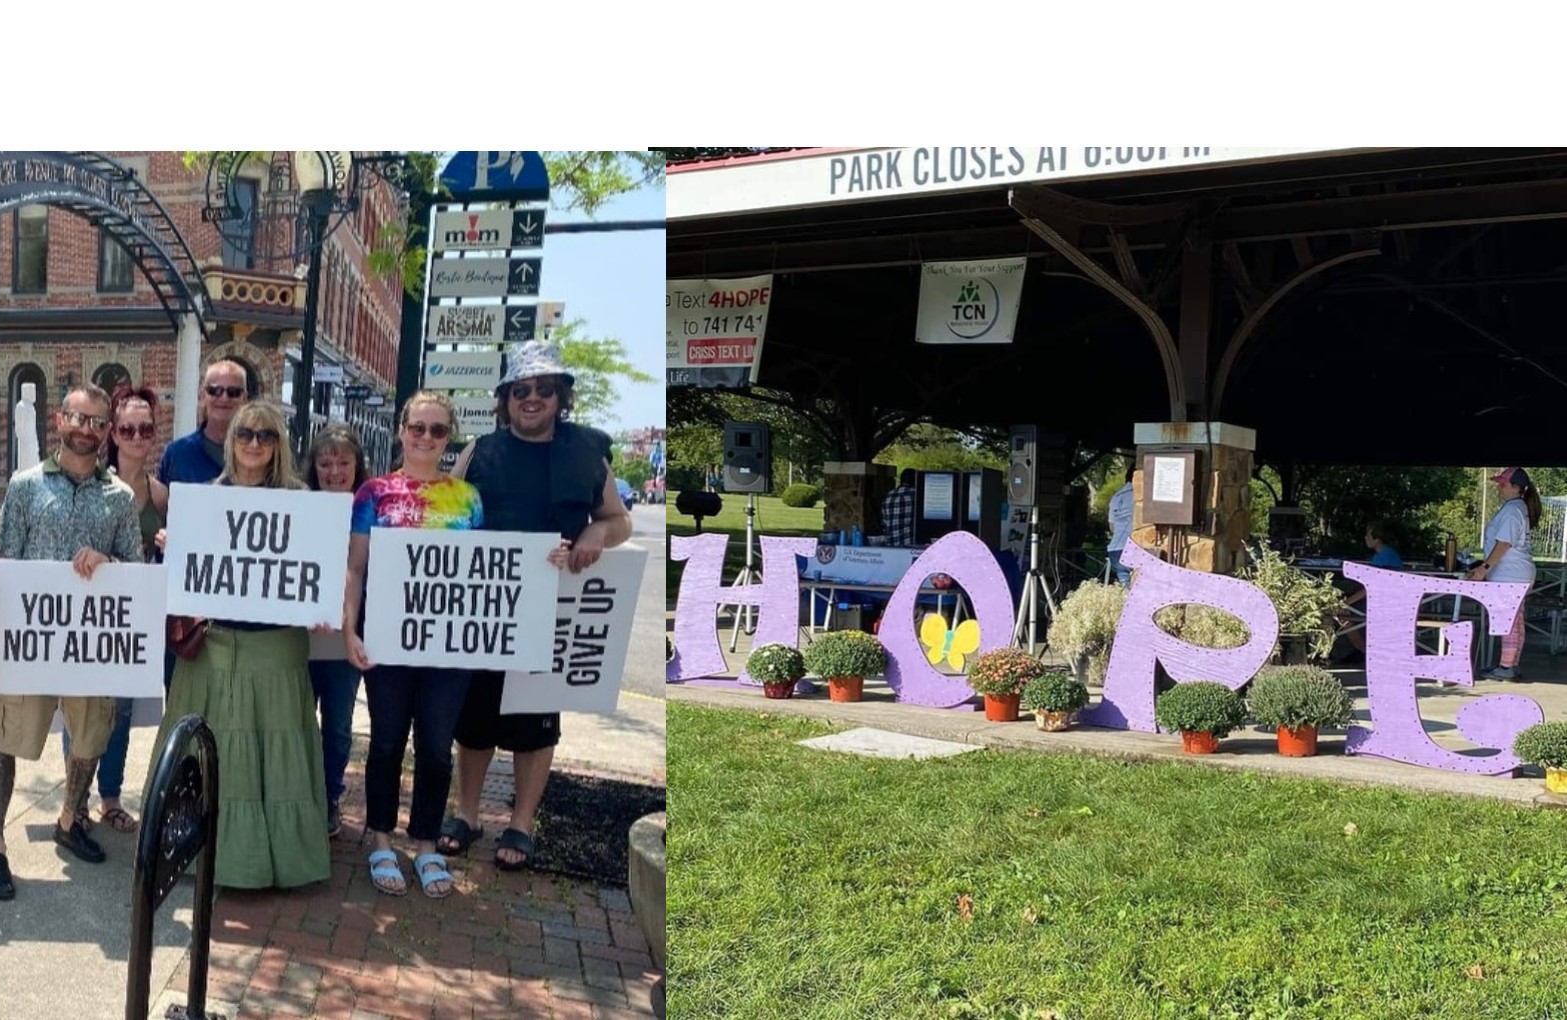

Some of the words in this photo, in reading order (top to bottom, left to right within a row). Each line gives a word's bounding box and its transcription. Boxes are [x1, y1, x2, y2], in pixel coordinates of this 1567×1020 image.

[830, 150, 903, 195] PARK
[913, 147, 1025, 186] CLOSES
[997, 263, 1025, 274] Support
[674, 290, 706, 308] Text
[708, 287, 770, 308] 4HOPE
[952, 304, 986, 320] TCN
[683, 319, 699, 335] to
[703, 316, 729, 334] 741
[689, 344, 716, 359] CRISIS
[718, 344, 742, 359] TEXT
[445, 366, 494, 376] JAZZERCISE
[670, 370, 690, 382] Life
[226, 509, 291, 554] YOU
[184, 552, 321, 603] MATTER
[406, 543, 460, 579] YOU
[467, 546, 523, 581] ARE
[21, 593, 72, 628] YOU
[80, 594, 133, 628] ARE
[403, 581, 522, 618] WORTHY
[578, 577, 616, 614] UP
[3, 629, 56, 662] NOT
[62, 630, 148, 665] ALONE
[401, 618, 436, 651] OF
[444, 620, 518, 655] LOVE
[566, 624, 609, 687] GIVE
